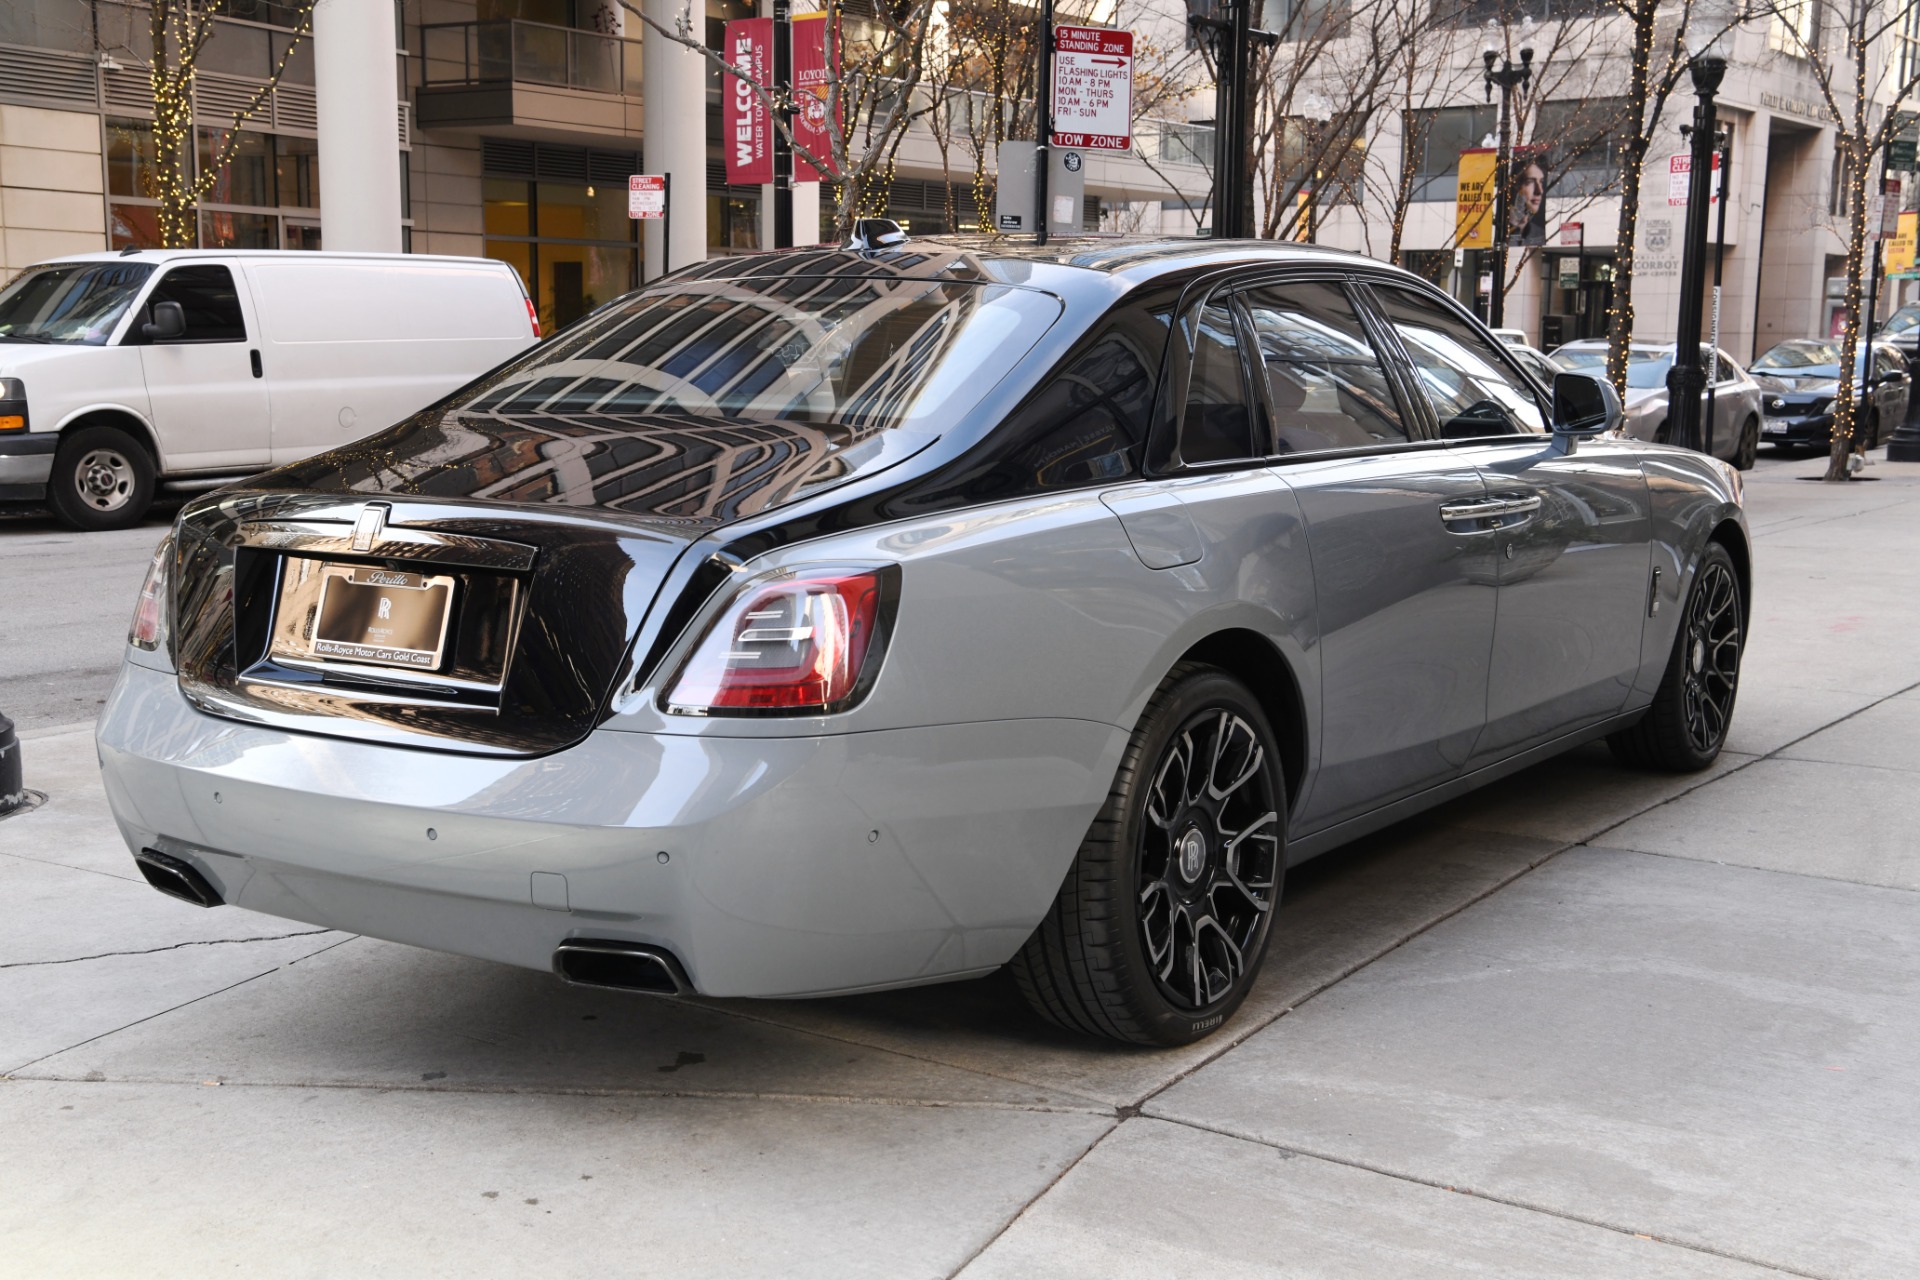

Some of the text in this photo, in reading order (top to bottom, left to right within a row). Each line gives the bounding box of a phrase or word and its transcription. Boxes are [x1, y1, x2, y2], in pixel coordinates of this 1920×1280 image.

[1060, 30, 1101, 40] 15 MINUTE
[1060, 40, 1124, 53] STANDING ZONE
[1059, 56, 1075, 65] USE
[799, 69, 827, 81] LOYOL
[1058, 67, 1128, 80] FLASHING LIGHTS
[1059, 77, 1068, 85] 10
[1068, 77, 1082, 86] AM
[1090, 79, 1096, 87] 8
[1098, 79, 1110, 88] PM
[1058, 87, 1076, 96] MON
[1086, 88, 1114, 98] THURS
[736, 38, 752, 167] WELCOME
[755, 45, 763, 159] WATER TOWE CAMPUS
[1058, 97, 1066, 105] 10
[1067, 97, 1080, 106] AM
[1089, 99, 1094, 107] 6
[1096, 99, 1109, 108] PM
[1058, 107, 1071, 116] FRI
[1079, 108, 1097, 117] SUN
[1057, 133, 1123, 148] TOW ZONE
[1673, 157, 1692, 165] STRE
[1672, 164, 1691, 172] CLEA
[1461, 182, 1470, 191] WE
[1484, 192, 1491, 201] TO
[1670, 198, 1688, 206] TOW
[1634, 261, 1679, 270] CORBOY
[367, 571, 408, 585] Perillo
[316, 643, 431, 664] Rolls-Royce Motor Cars Gold Coast
